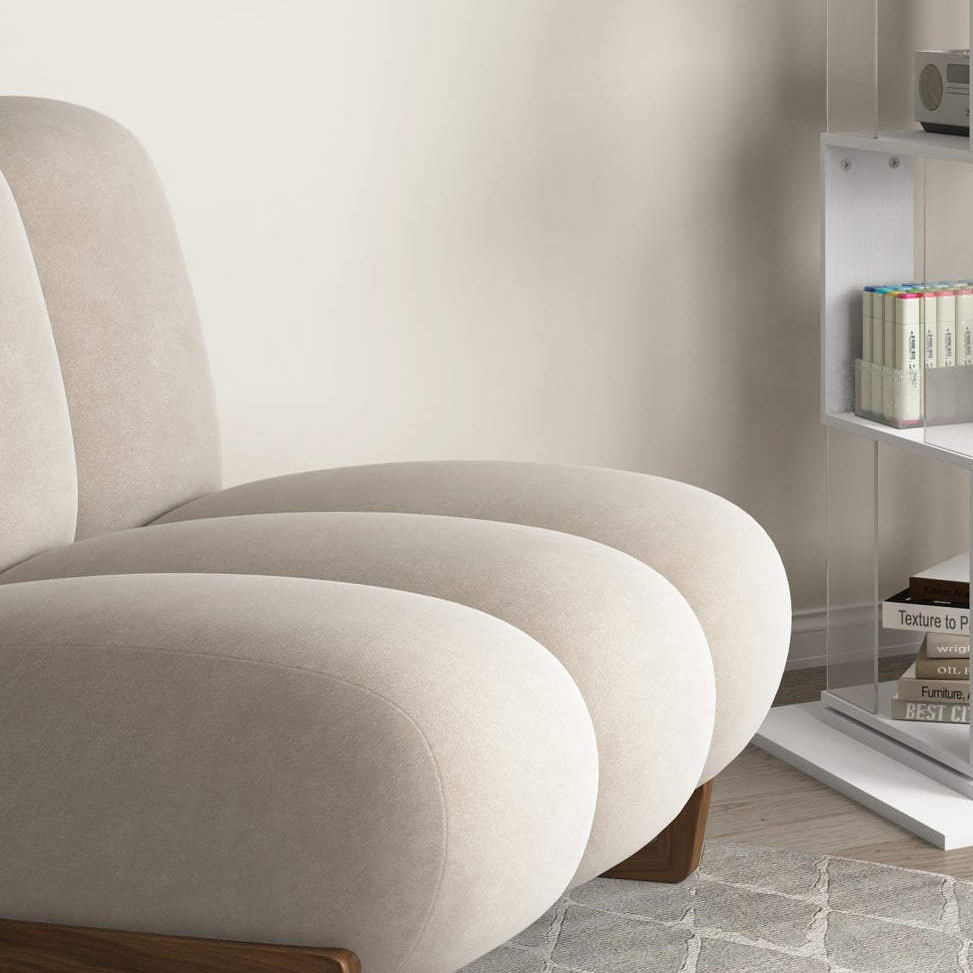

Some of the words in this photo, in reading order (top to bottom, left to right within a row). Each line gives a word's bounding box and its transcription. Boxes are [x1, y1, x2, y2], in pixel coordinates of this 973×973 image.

[898, 609, 942, 629] Texture
[944, 614, 957, 630] to
[937, 666, 961, 675] OIL
[903, 701, 947, 722] BEST
[950, 704, 970, 723] CI
